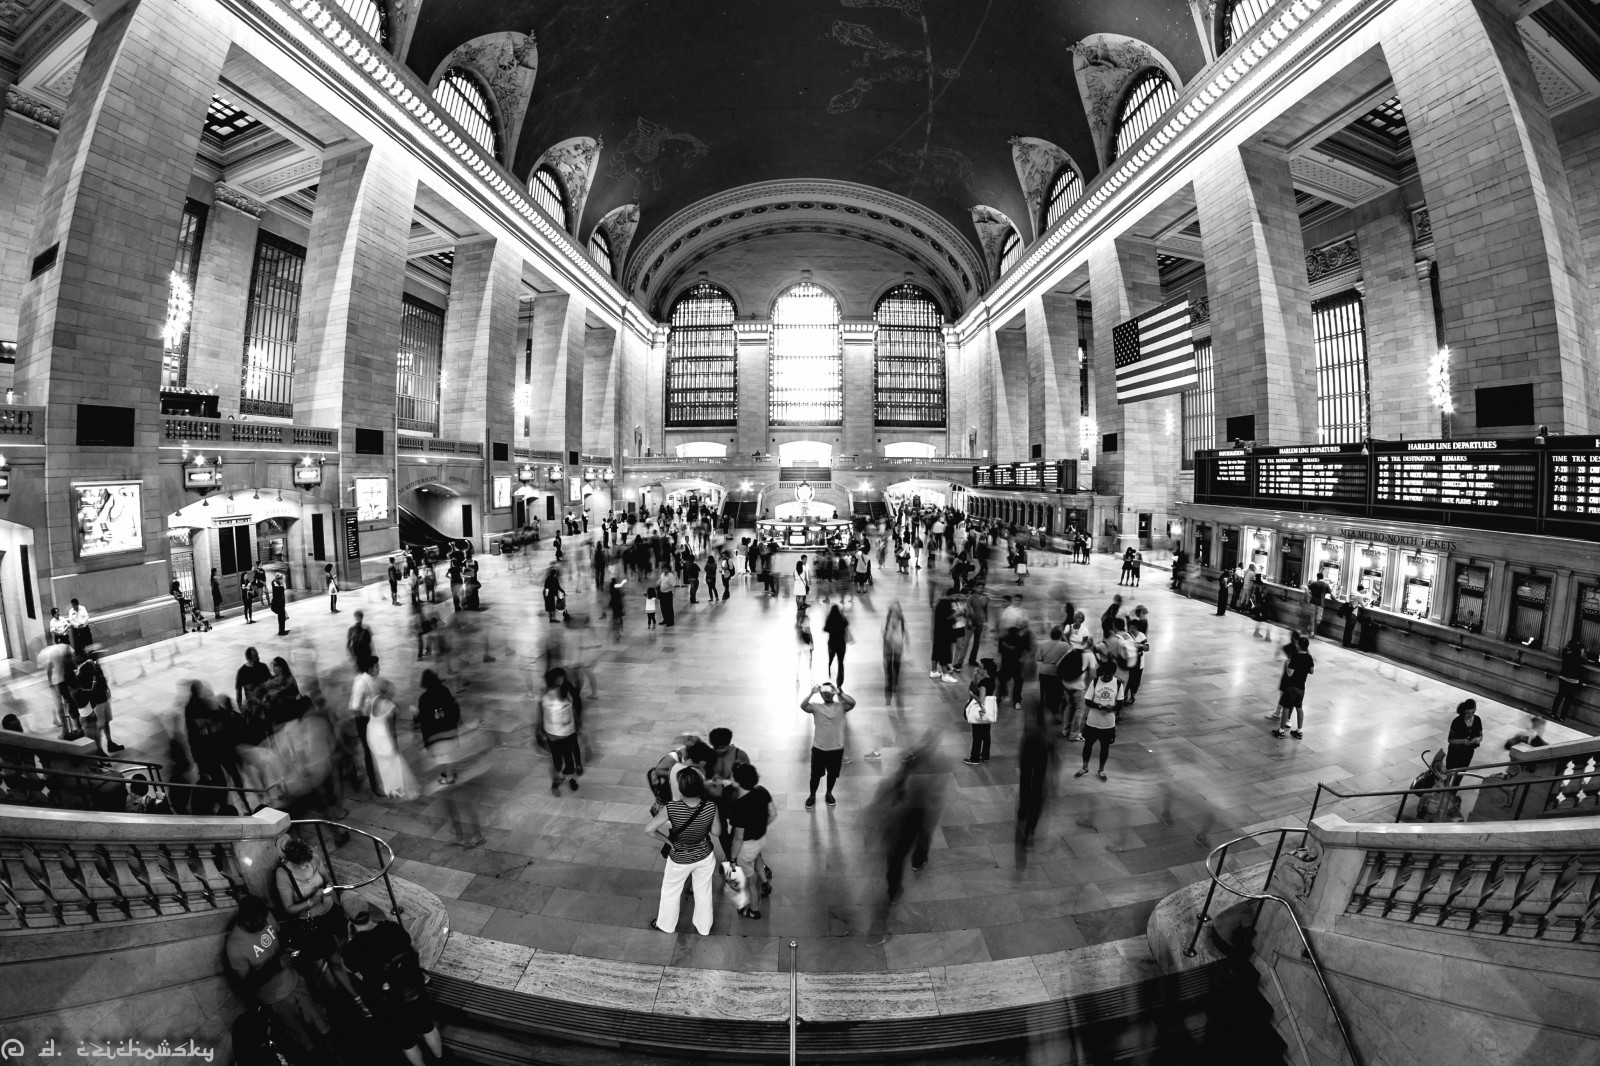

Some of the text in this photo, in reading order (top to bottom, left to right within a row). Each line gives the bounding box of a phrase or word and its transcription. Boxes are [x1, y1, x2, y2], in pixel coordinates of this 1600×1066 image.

[1453, 441, 1497, 449] DEPARTURES
[1340, 529, 1356, 538] MTA
[1420, 537, 1457, 551] TICKETS
